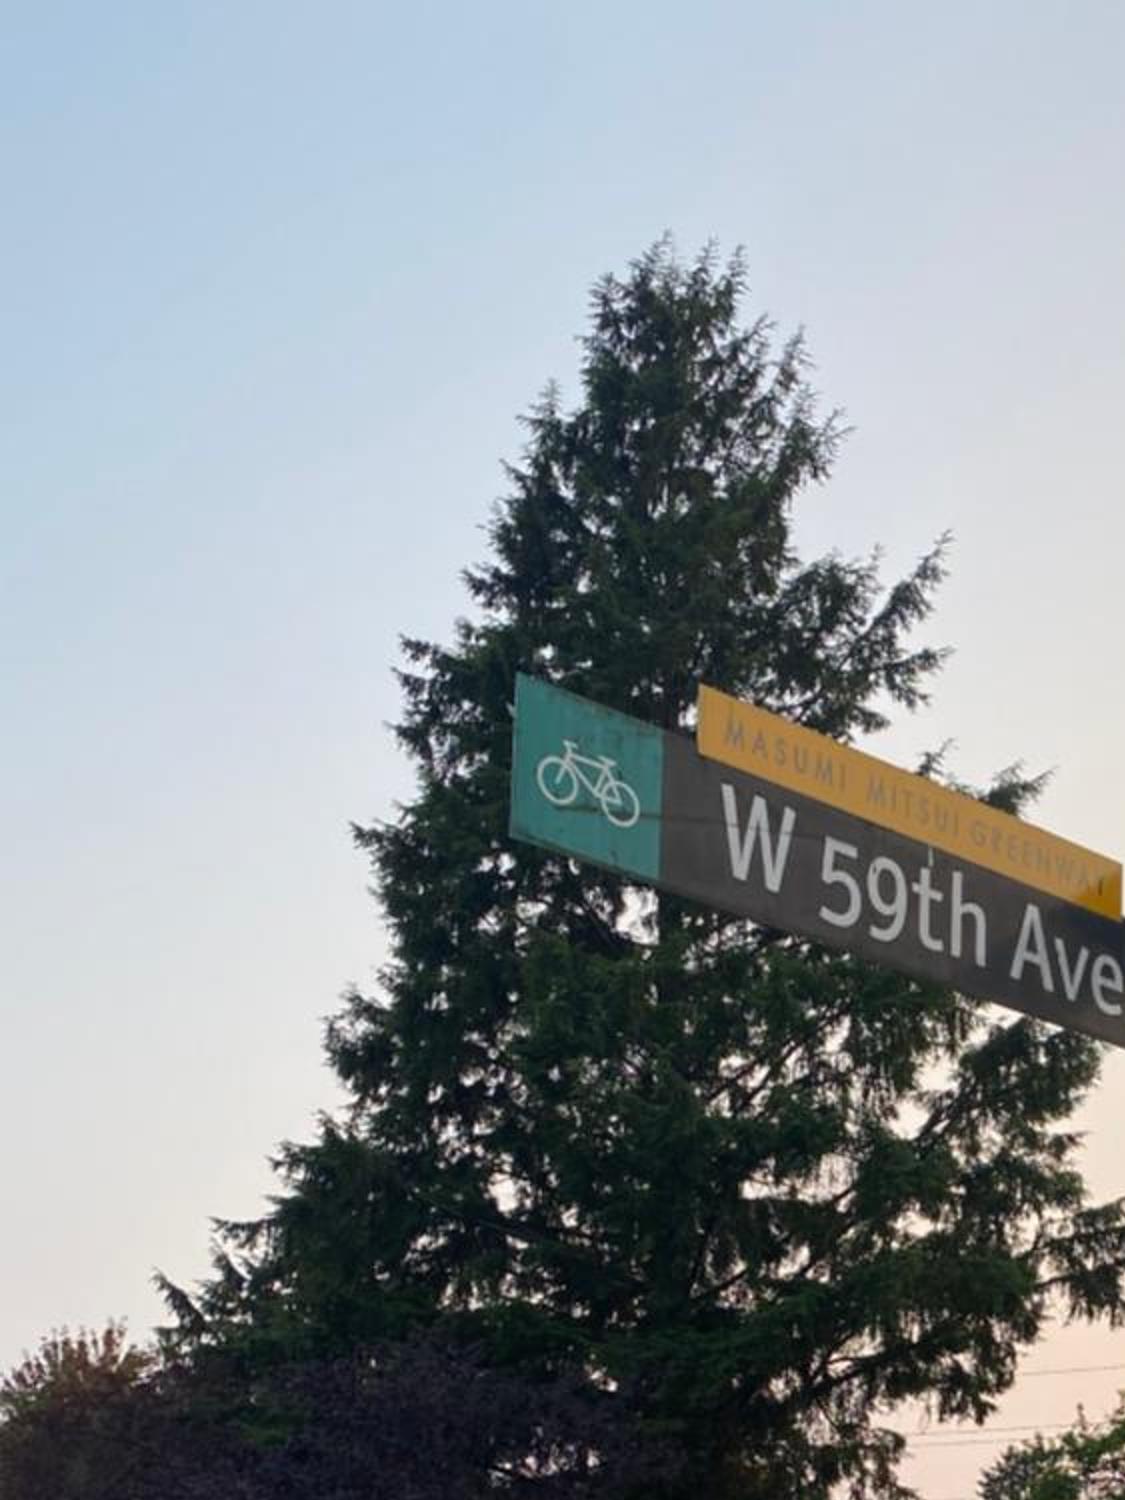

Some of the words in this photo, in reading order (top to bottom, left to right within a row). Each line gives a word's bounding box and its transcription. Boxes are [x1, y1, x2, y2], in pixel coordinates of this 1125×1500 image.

[719, 783, 796, 893] W
[818, 837, 988, 967] 59th
[725, 713, 847, 793] MASUMI
[866, 771, 960, 836] MITSUI
[969, 819, 1106, 896] GREENWAY
